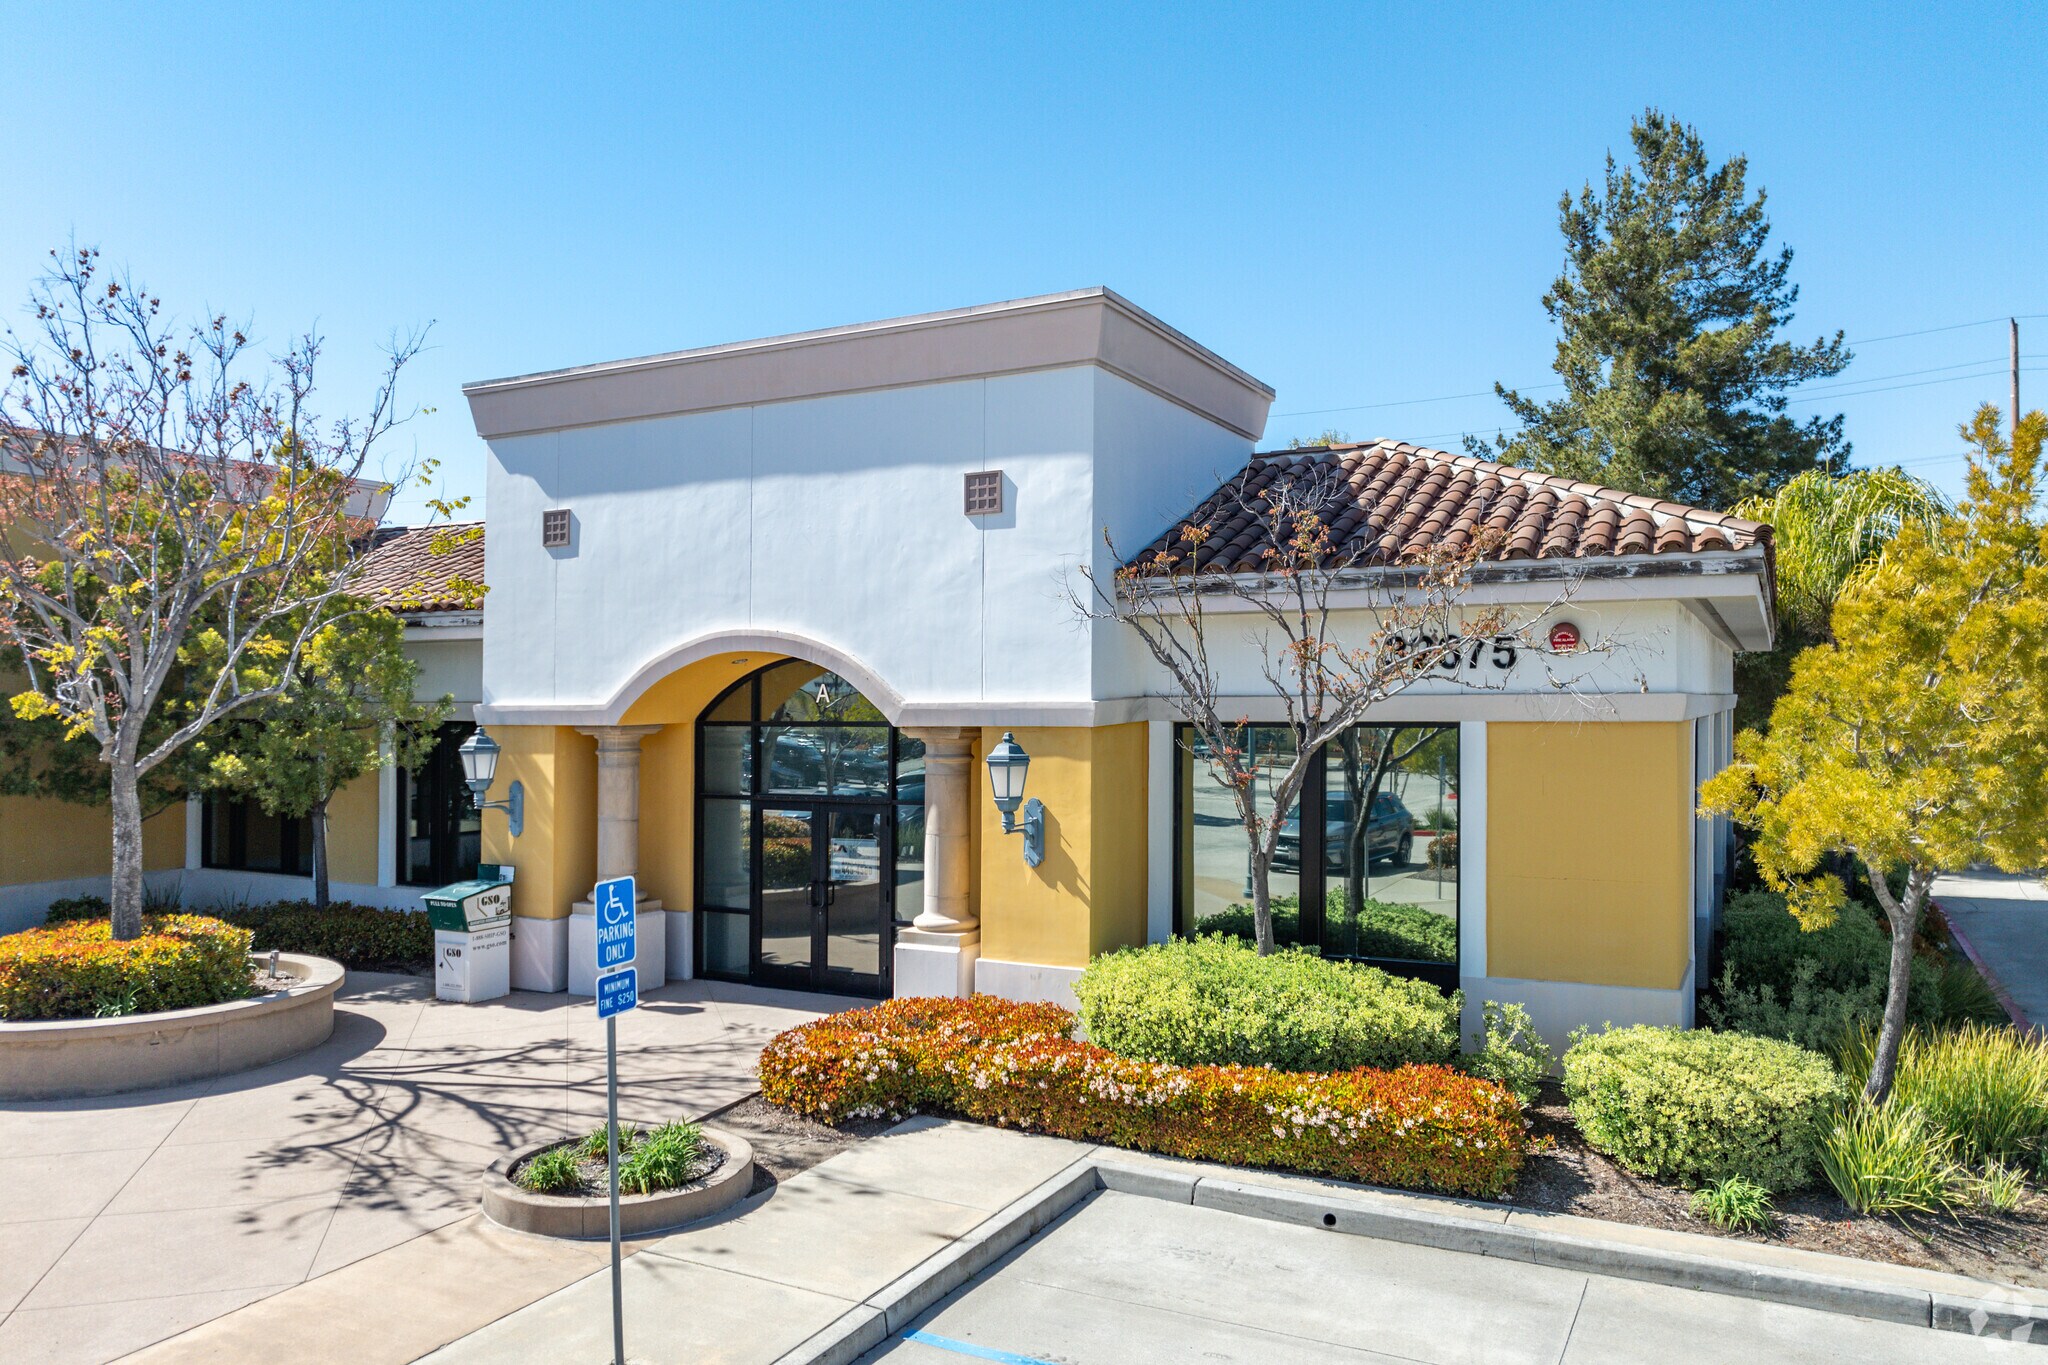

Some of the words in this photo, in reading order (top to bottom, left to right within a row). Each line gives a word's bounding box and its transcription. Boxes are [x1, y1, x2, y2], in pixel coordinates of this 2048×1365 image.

[816, 684, 830, 703] A
[481, 894, 500, 906] GSO
[598, 921, 634, 944] PARKING
[446, 948, 462, 957] GSO
[472, 941, 507, 951] www.gso.com
[605, 942, 627, 962] ONLY
[604, 978, 630, 994] MINIMUM
[600, 997, 613, 1010] FINE
[618, 991, 634, 1005] $250
